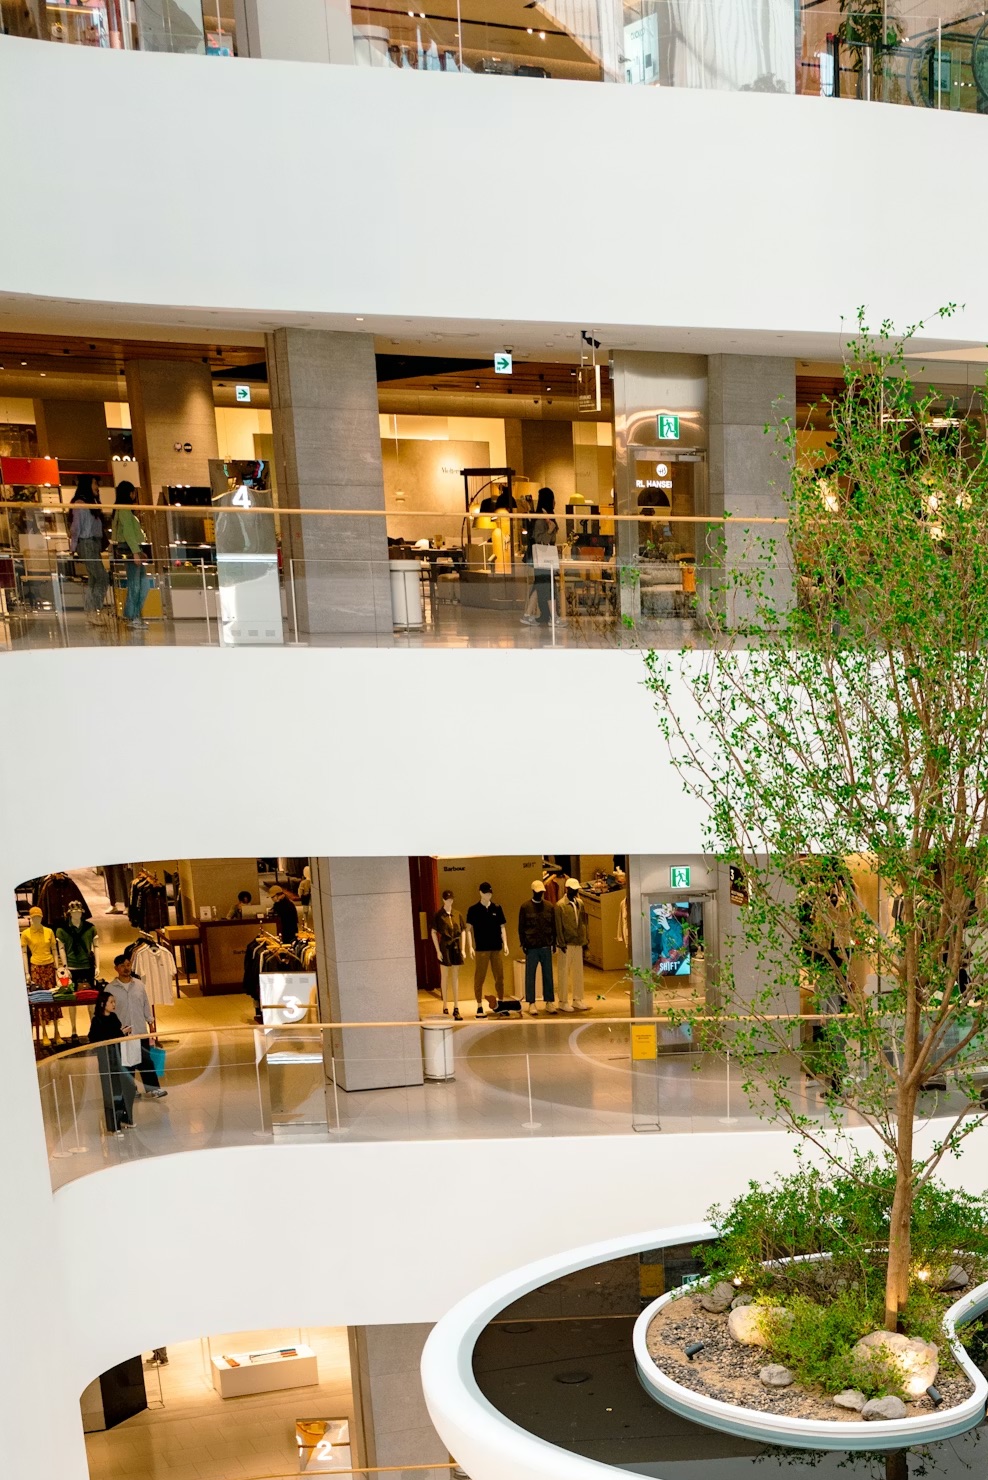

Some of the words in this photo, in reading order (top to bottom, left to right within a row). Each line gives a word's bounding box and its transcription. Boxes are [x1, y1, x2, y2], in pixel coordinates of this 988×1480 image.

[232, 485, 251, 509] 4
[282, 995, 302, 1019] 3
[316, 1440, 333, 1461] 2
